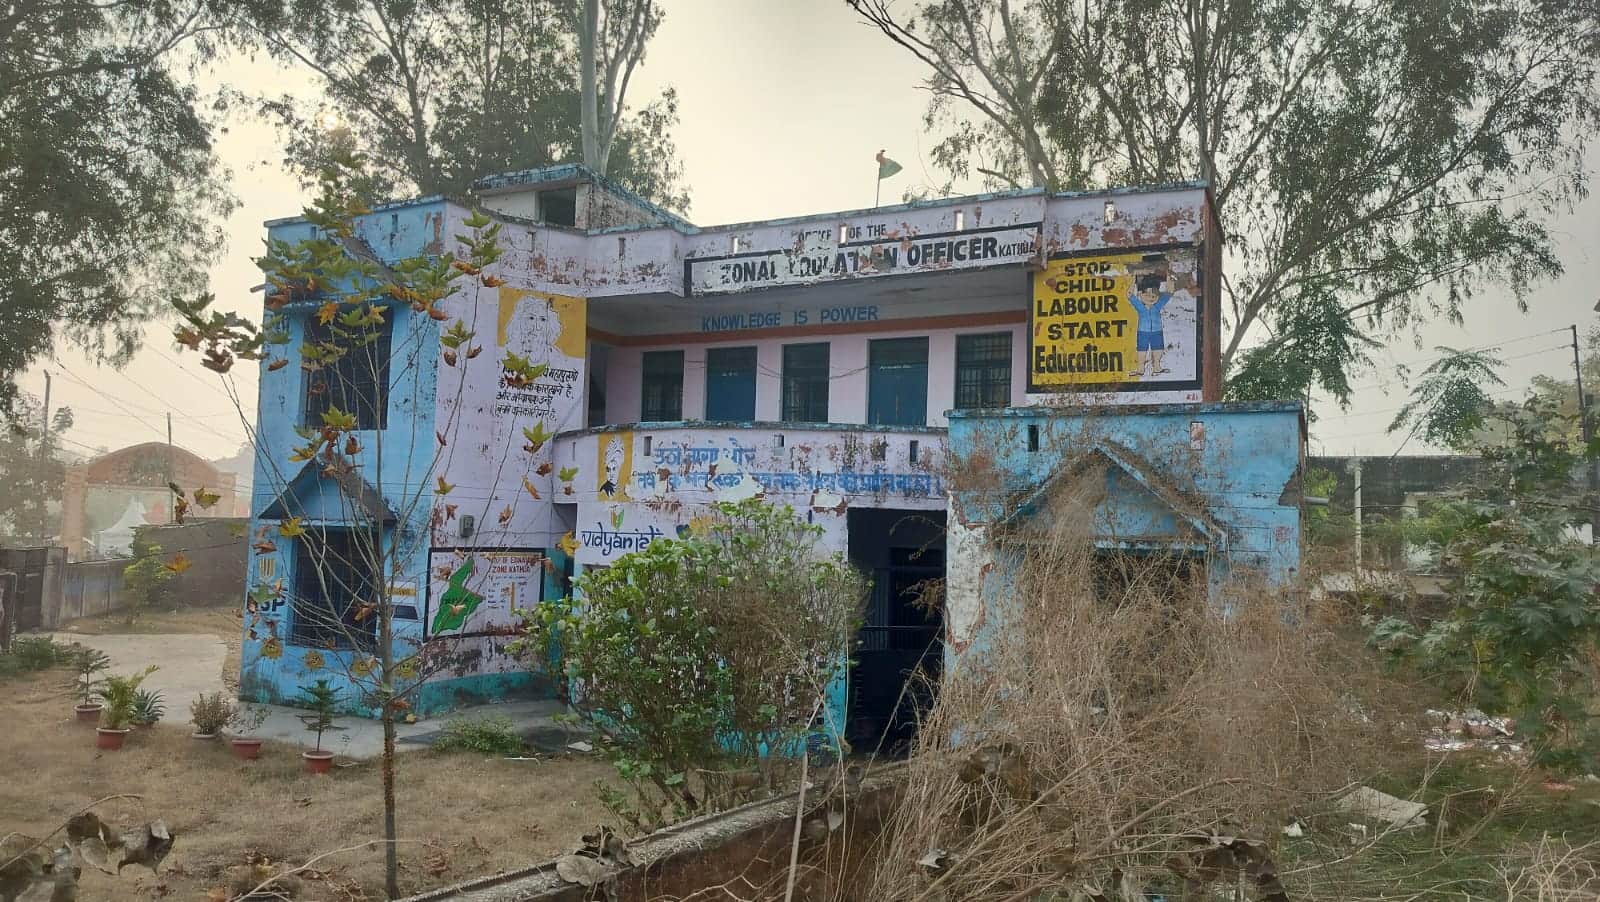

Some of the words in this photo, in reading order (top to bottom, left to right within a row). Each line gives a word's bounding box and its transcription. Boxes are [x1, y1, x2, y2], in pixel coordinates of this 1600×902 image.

[848, 227, 862, 239] OF
[866, 223, 887, 237] THE
[907, 236, 998, 267] OFFICER
[1064, 261, 1111, 277] STOP
[1055, 278, 1115, 294] CHILD
[1037, 295, 1119, 318] LABOUR
[702, 311, 781, 332] KNOWLEDGE
[793, 310, 808, 325] IS
[820, 305, 879, 323] POWER
[1047, 319, 1128, 341] START
[1035, 343, 1123, 374] Education
